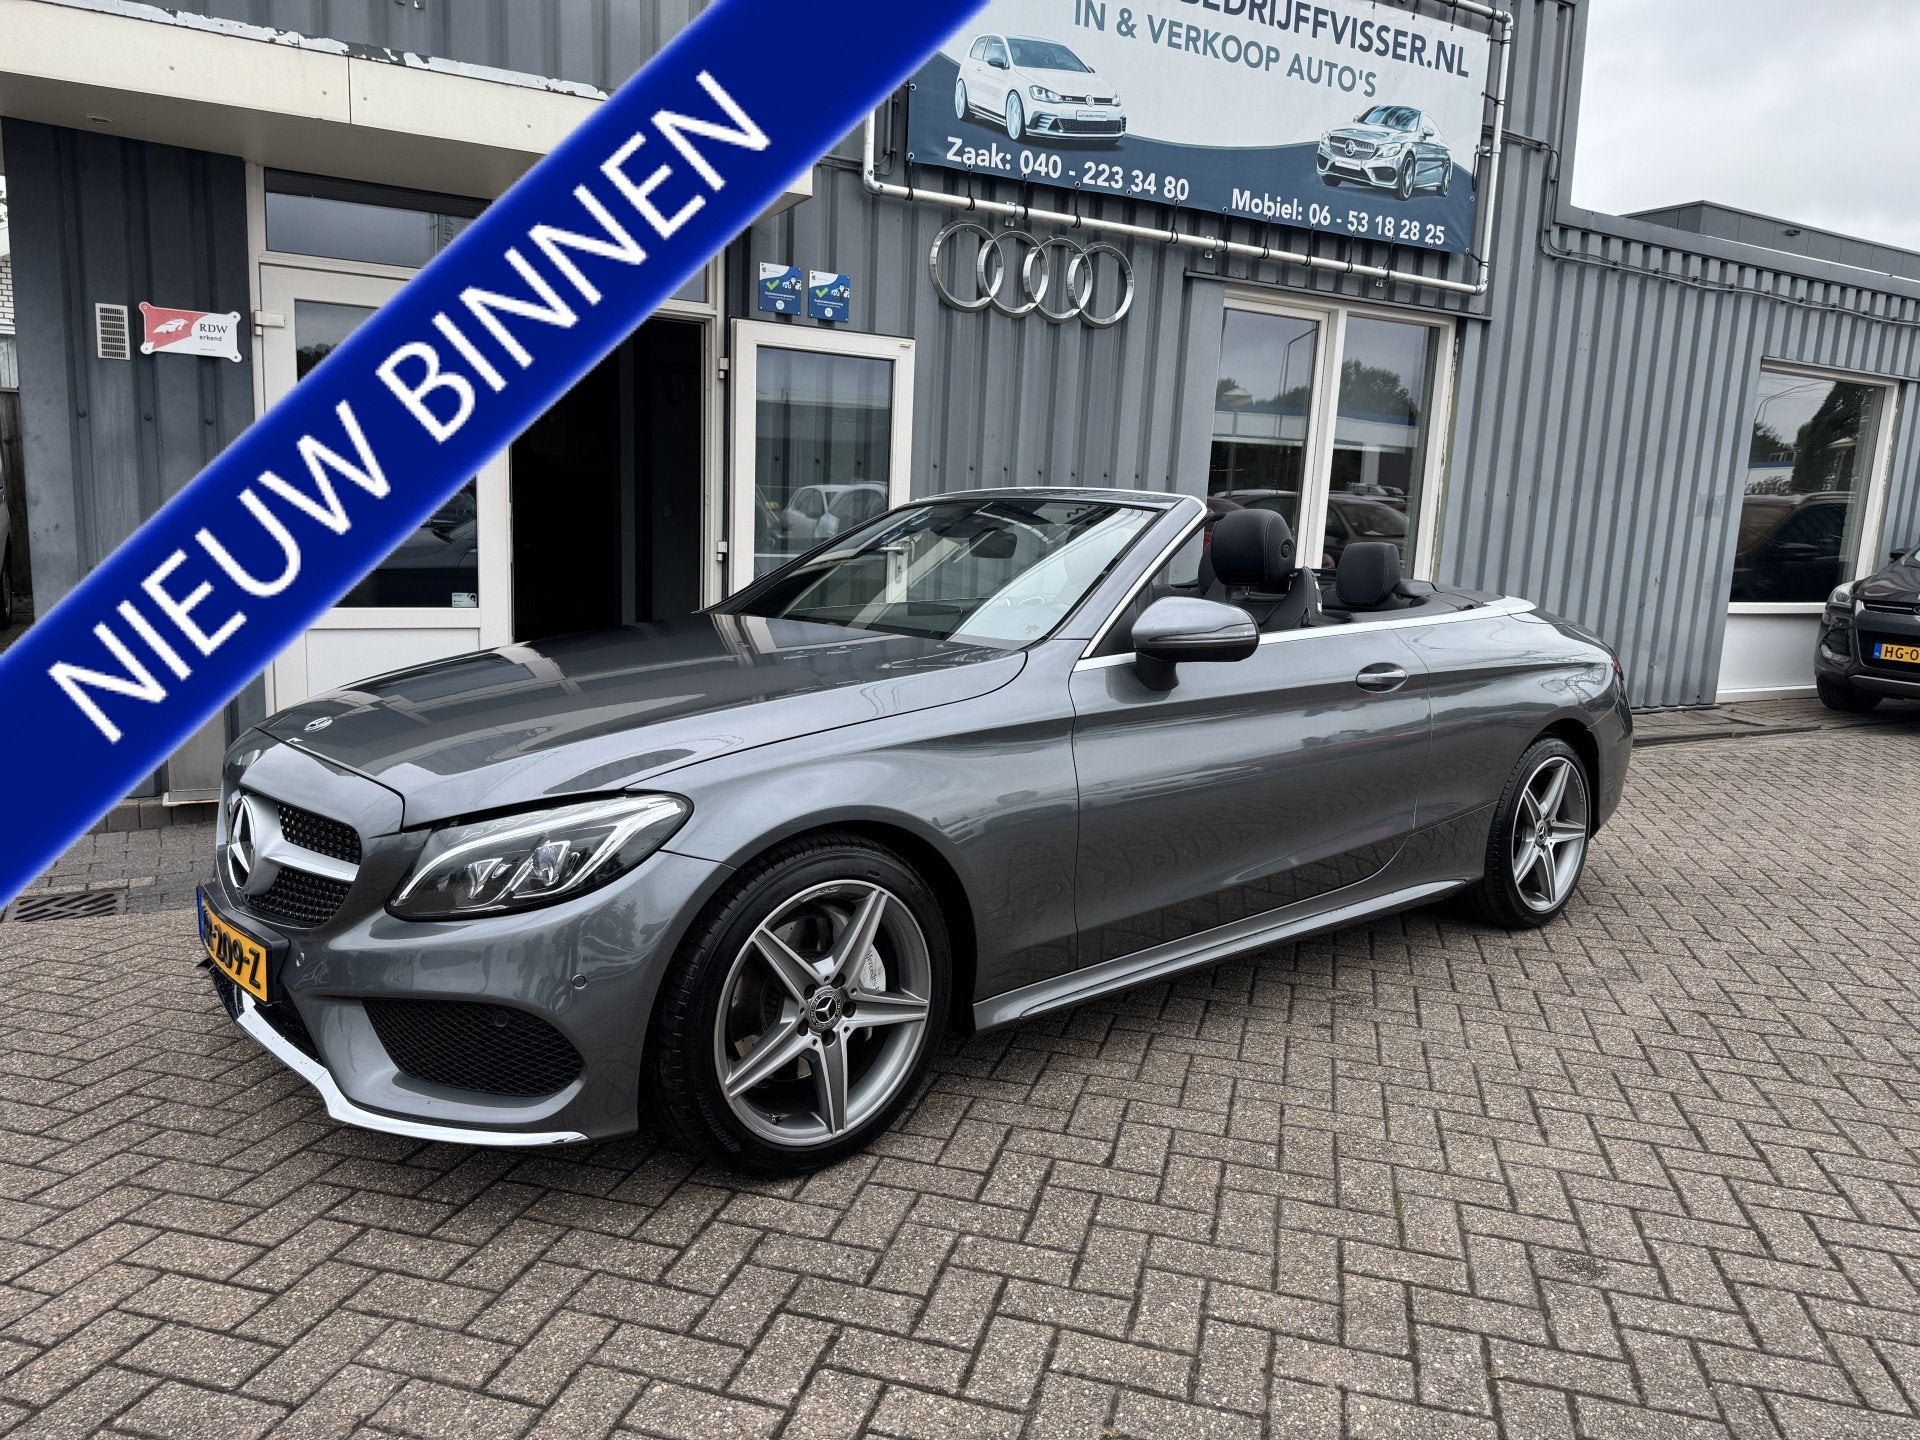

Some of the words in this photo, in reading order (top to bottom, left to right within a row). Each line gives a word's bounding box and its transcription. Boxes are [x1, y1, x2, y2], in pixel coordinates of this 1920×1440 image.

[1075, 0, 1106, 31] IN
[1116, 7, 1137, 39] &
[1147, 14, 1281, 71] VERKOOP
[1286, 53, 1377, 98] AUTO'S
[1180, 0, 1469, 78] DRIJFFVISSER.NL
[946, 136, 1012, 170] Zaak:
[1019, 150, 1062, 178] 040
[1082, 161, 1124, 189] 223
[1130, 169, 1157, 195] 34
[1163, 175, 1190, 201] 80
[1231, 188, 1303, 221] Mobiel:
[1308, 203, 1331, 225] 06
[1347, 210, 1368, 232] 53
[1374, 215, 1394, 237] 18
[1399, 219, 1420, 241] 28
[1425, 223, 1446, 245] 25
[200, 324, 228, 333] RDW
